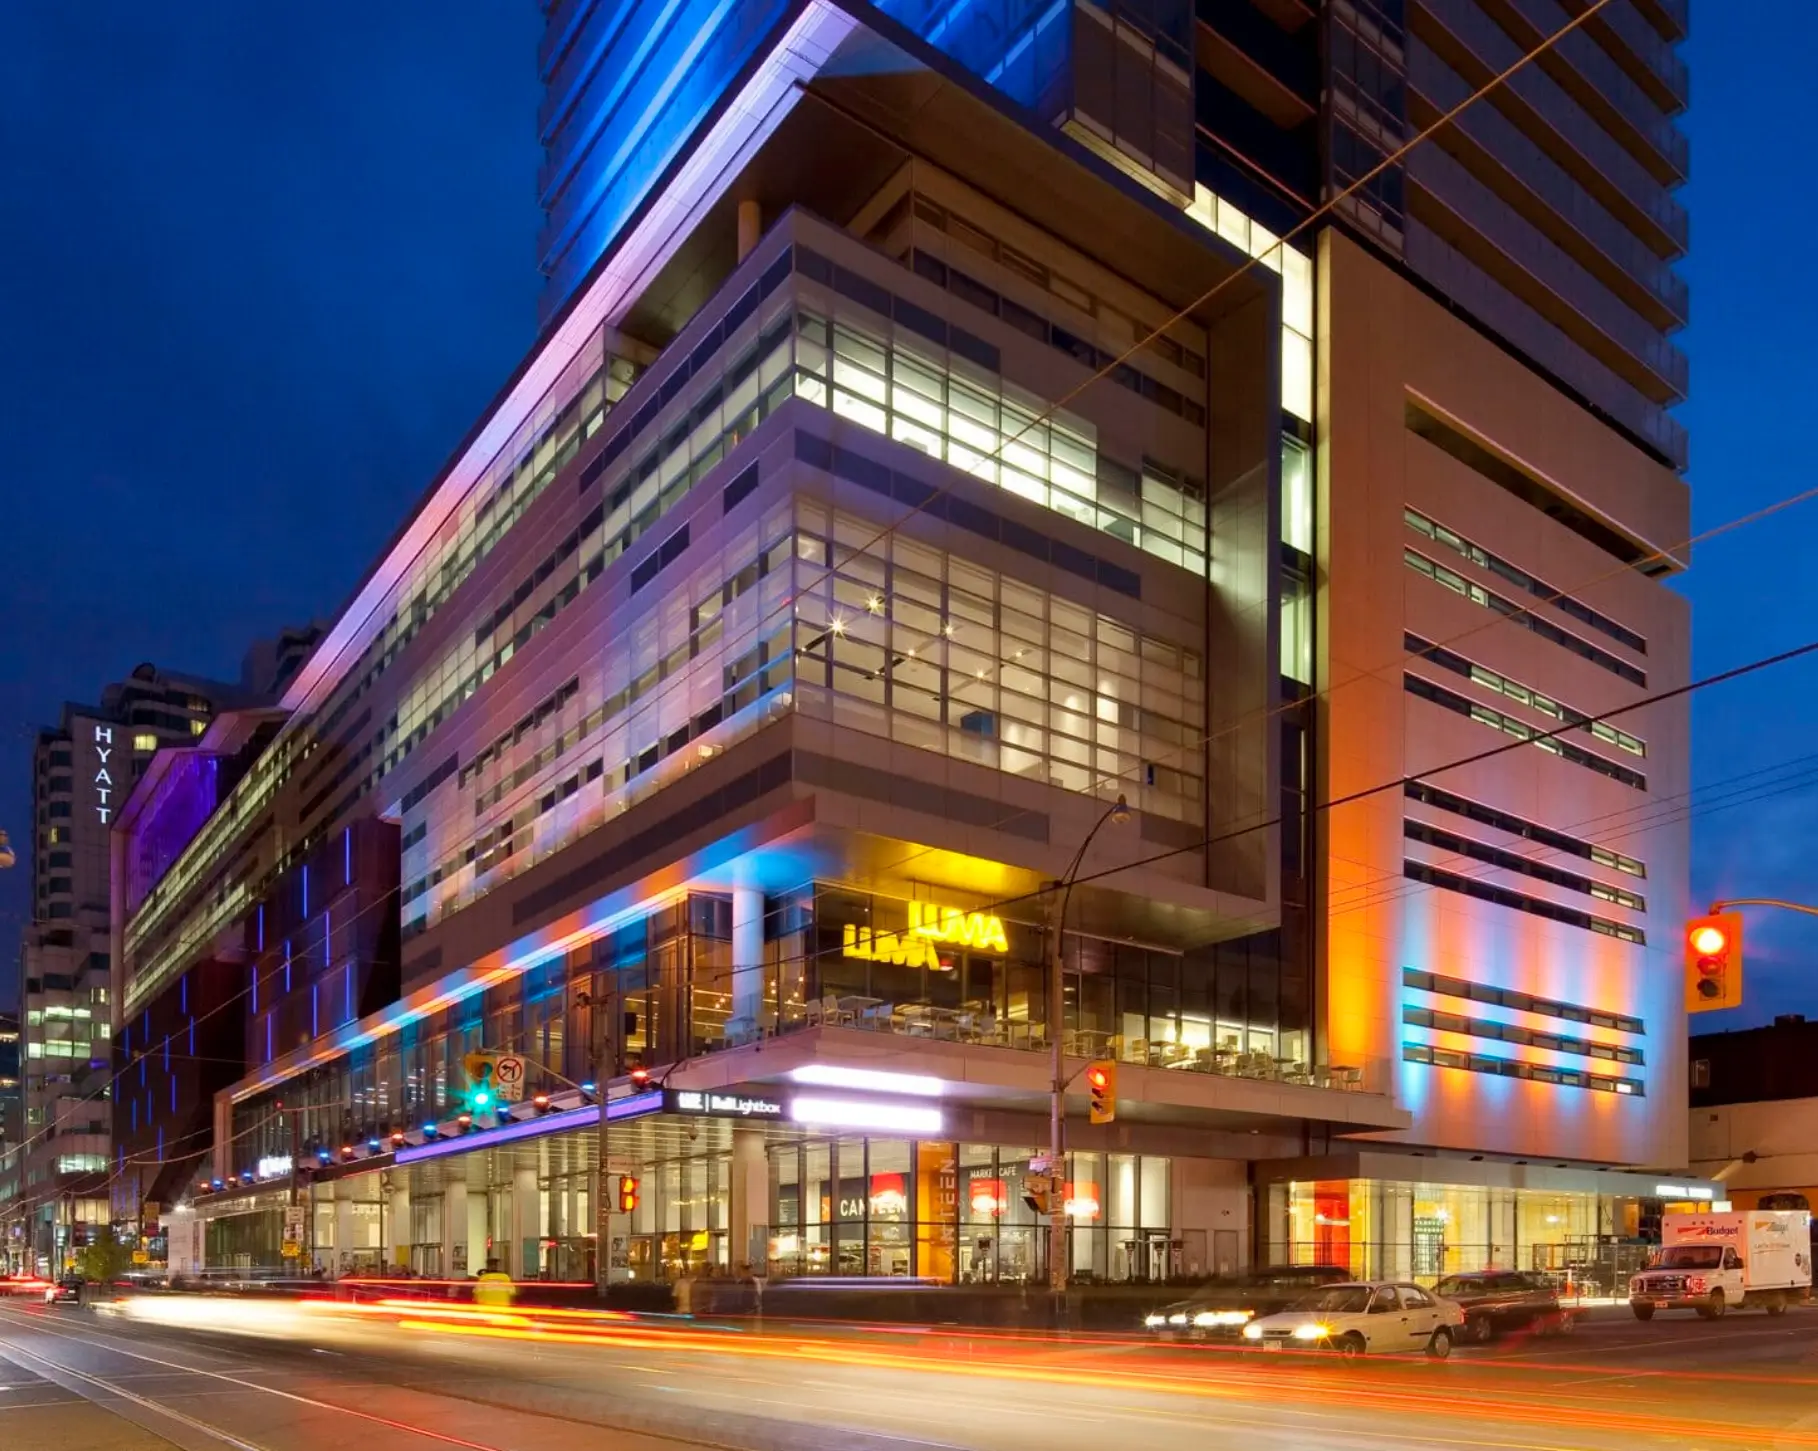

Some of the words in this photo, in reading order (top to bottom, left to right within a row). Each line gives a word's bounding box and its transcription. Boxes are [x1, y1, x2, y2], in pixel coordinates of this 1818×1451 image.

[94, 725, 112, 824] HYATT
[908, 900, 1009, 952] LUMA
[1706, 1226, 1739, 1236] Budget
